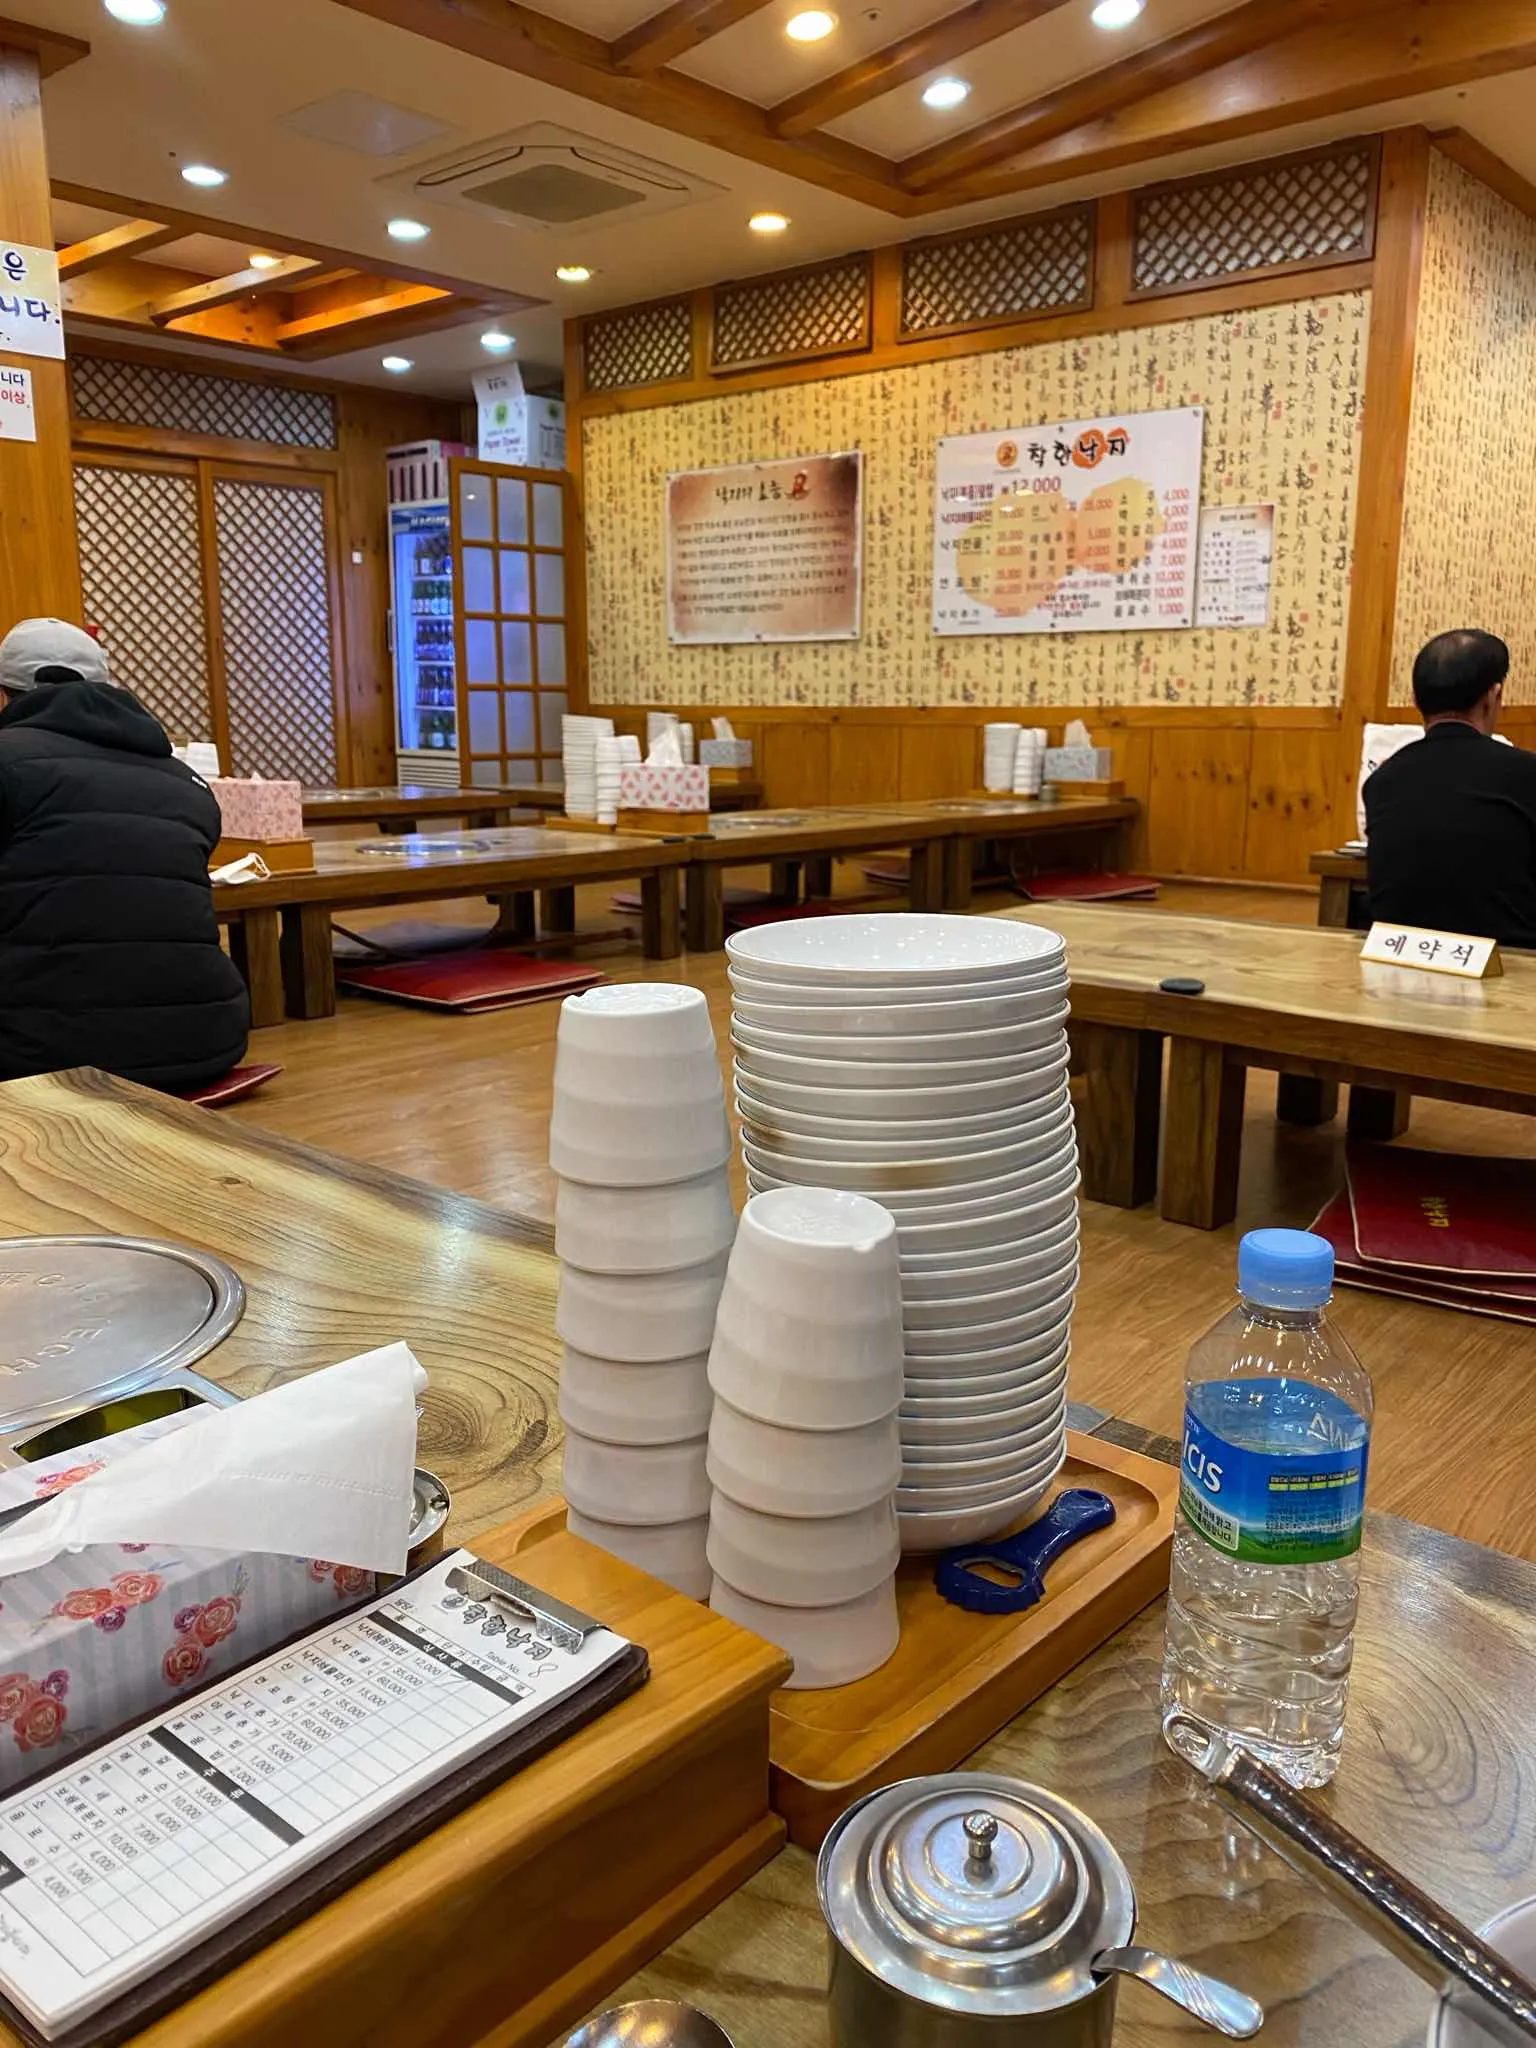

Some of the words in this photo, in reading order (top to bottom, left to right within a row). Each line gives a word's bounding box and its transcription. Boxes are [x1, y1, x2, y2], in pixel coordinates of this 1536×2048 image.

[1385, 934, 1474, 967] 예약석
[413, 1657, 442, 1676] 12,000
[392, 1667, 423, 1687] 35,000
